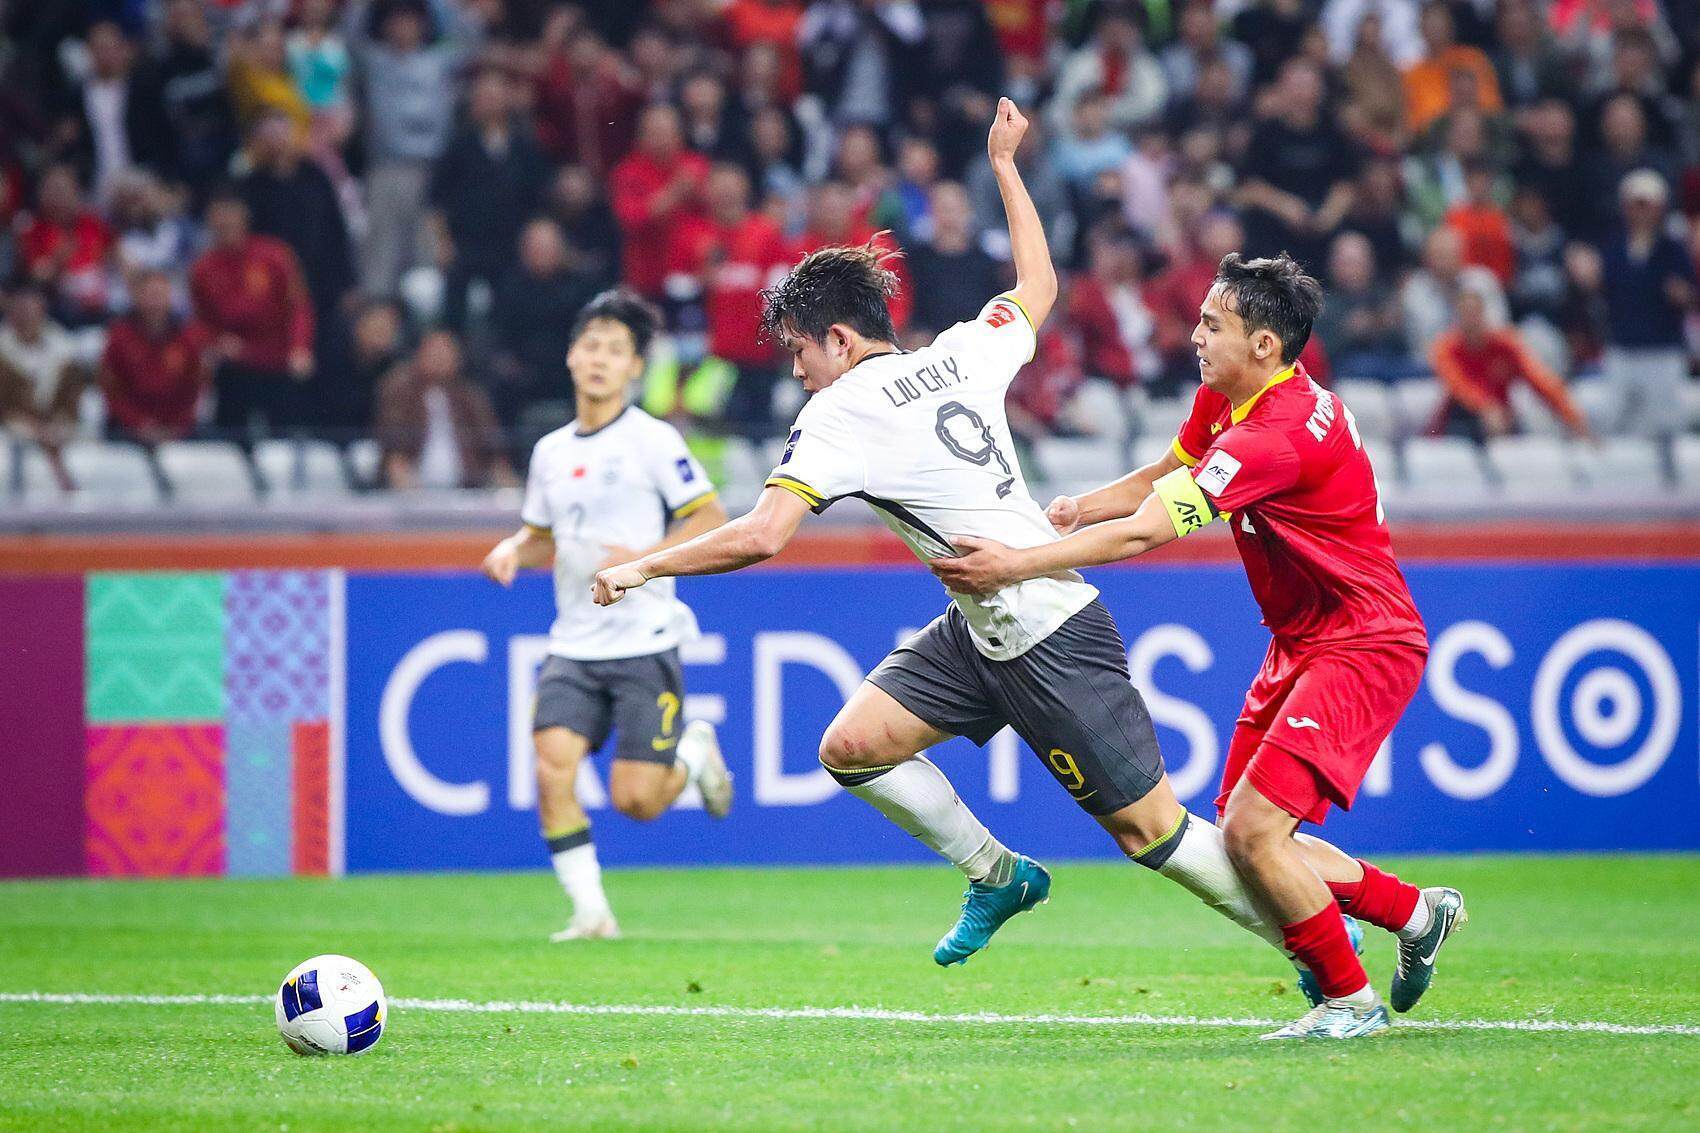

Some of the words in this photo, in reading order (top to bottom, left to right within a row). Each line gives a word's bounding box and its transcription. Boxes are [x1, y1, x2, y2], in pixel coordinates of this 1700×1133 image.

[881, 366, 922, 408] LIU
[915, 356, 969, 393] CH.Y.
[934, 400, 1016, 500] 9
[1208, 465, 1232, 481] AFC
[656, 690, 682, 737] 7
[1048, 747, 1085, 791] 9
